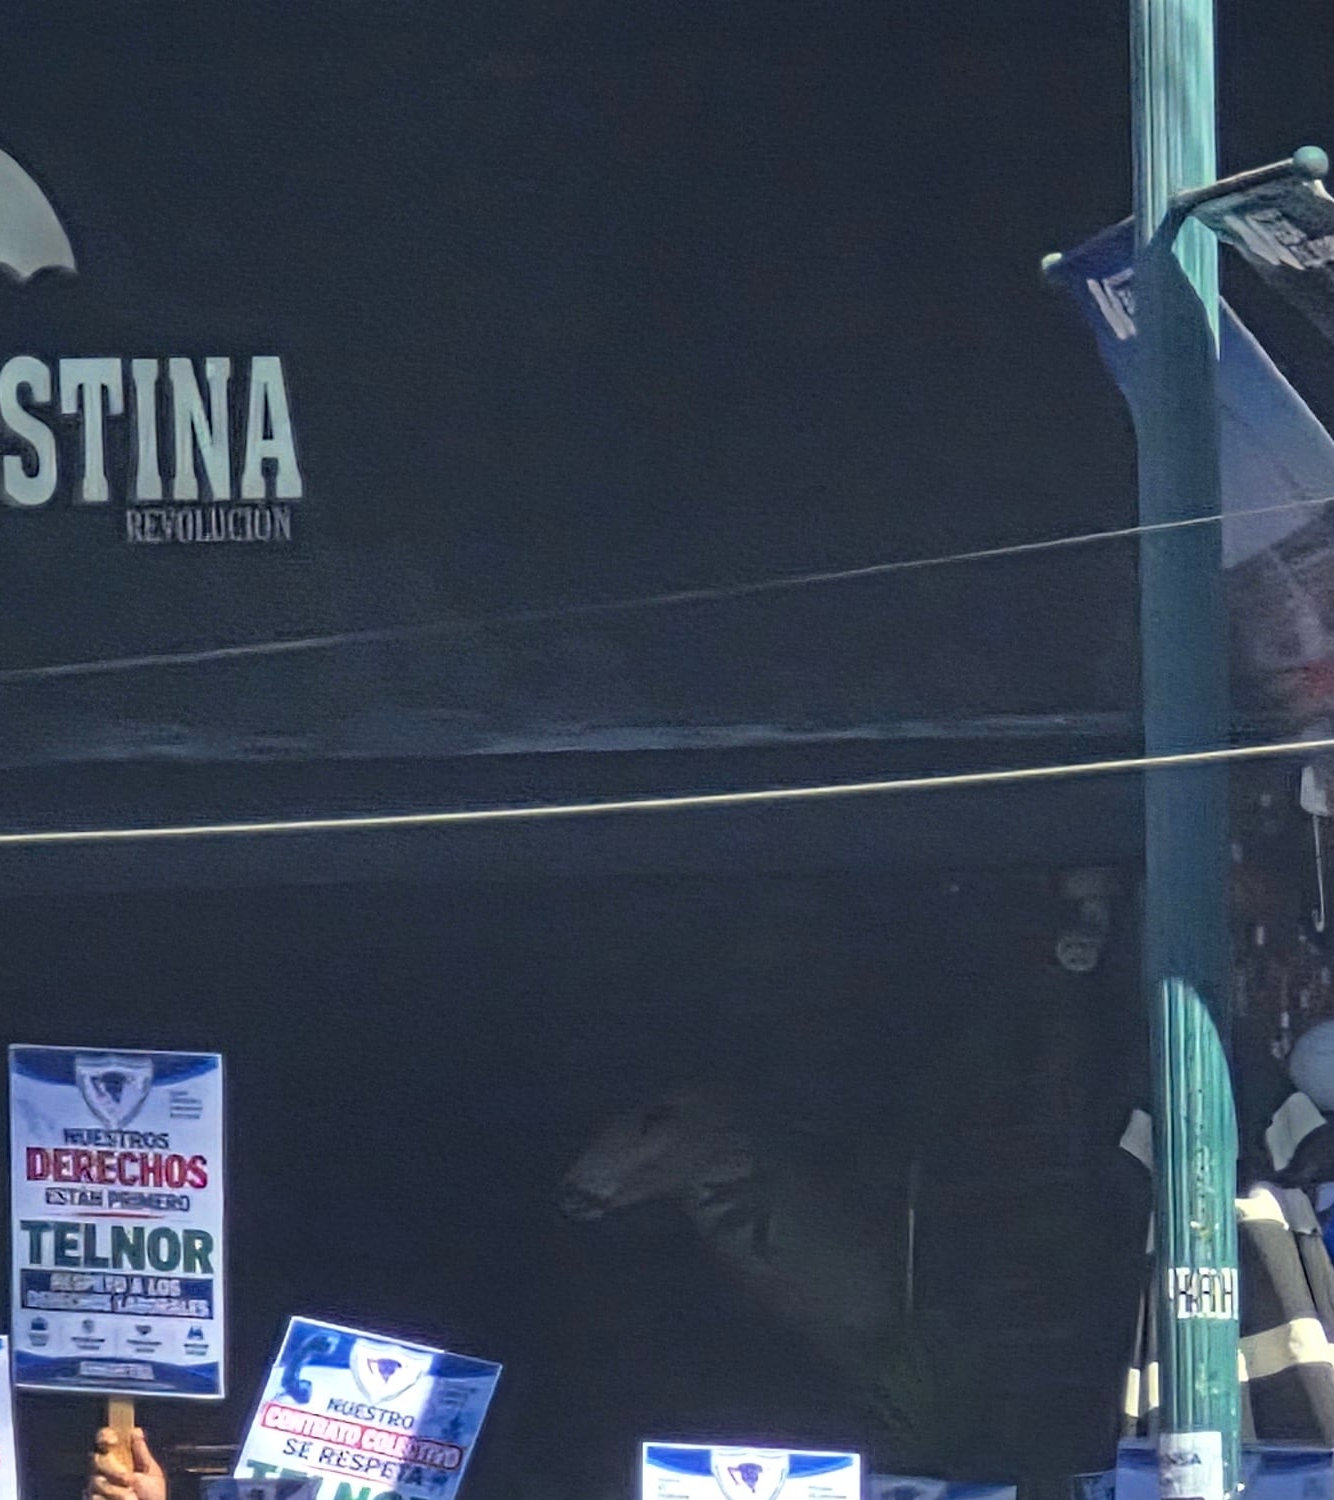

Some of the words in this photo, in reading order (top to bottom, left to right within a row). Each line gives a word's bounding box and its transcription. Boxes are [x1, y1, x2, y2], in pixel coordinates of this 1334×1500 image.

[64, 1128, 169, 1150] NUESTROS
[26, 1147, 208, 1189] DERECHOS
[20, 1220, 214, 1273] TELNOR
[326, 1397, 415, 1430] NUESTRO
[283, 1438, 312, 1462] SE
[319, 1447, 424, 1487] RESPETA
